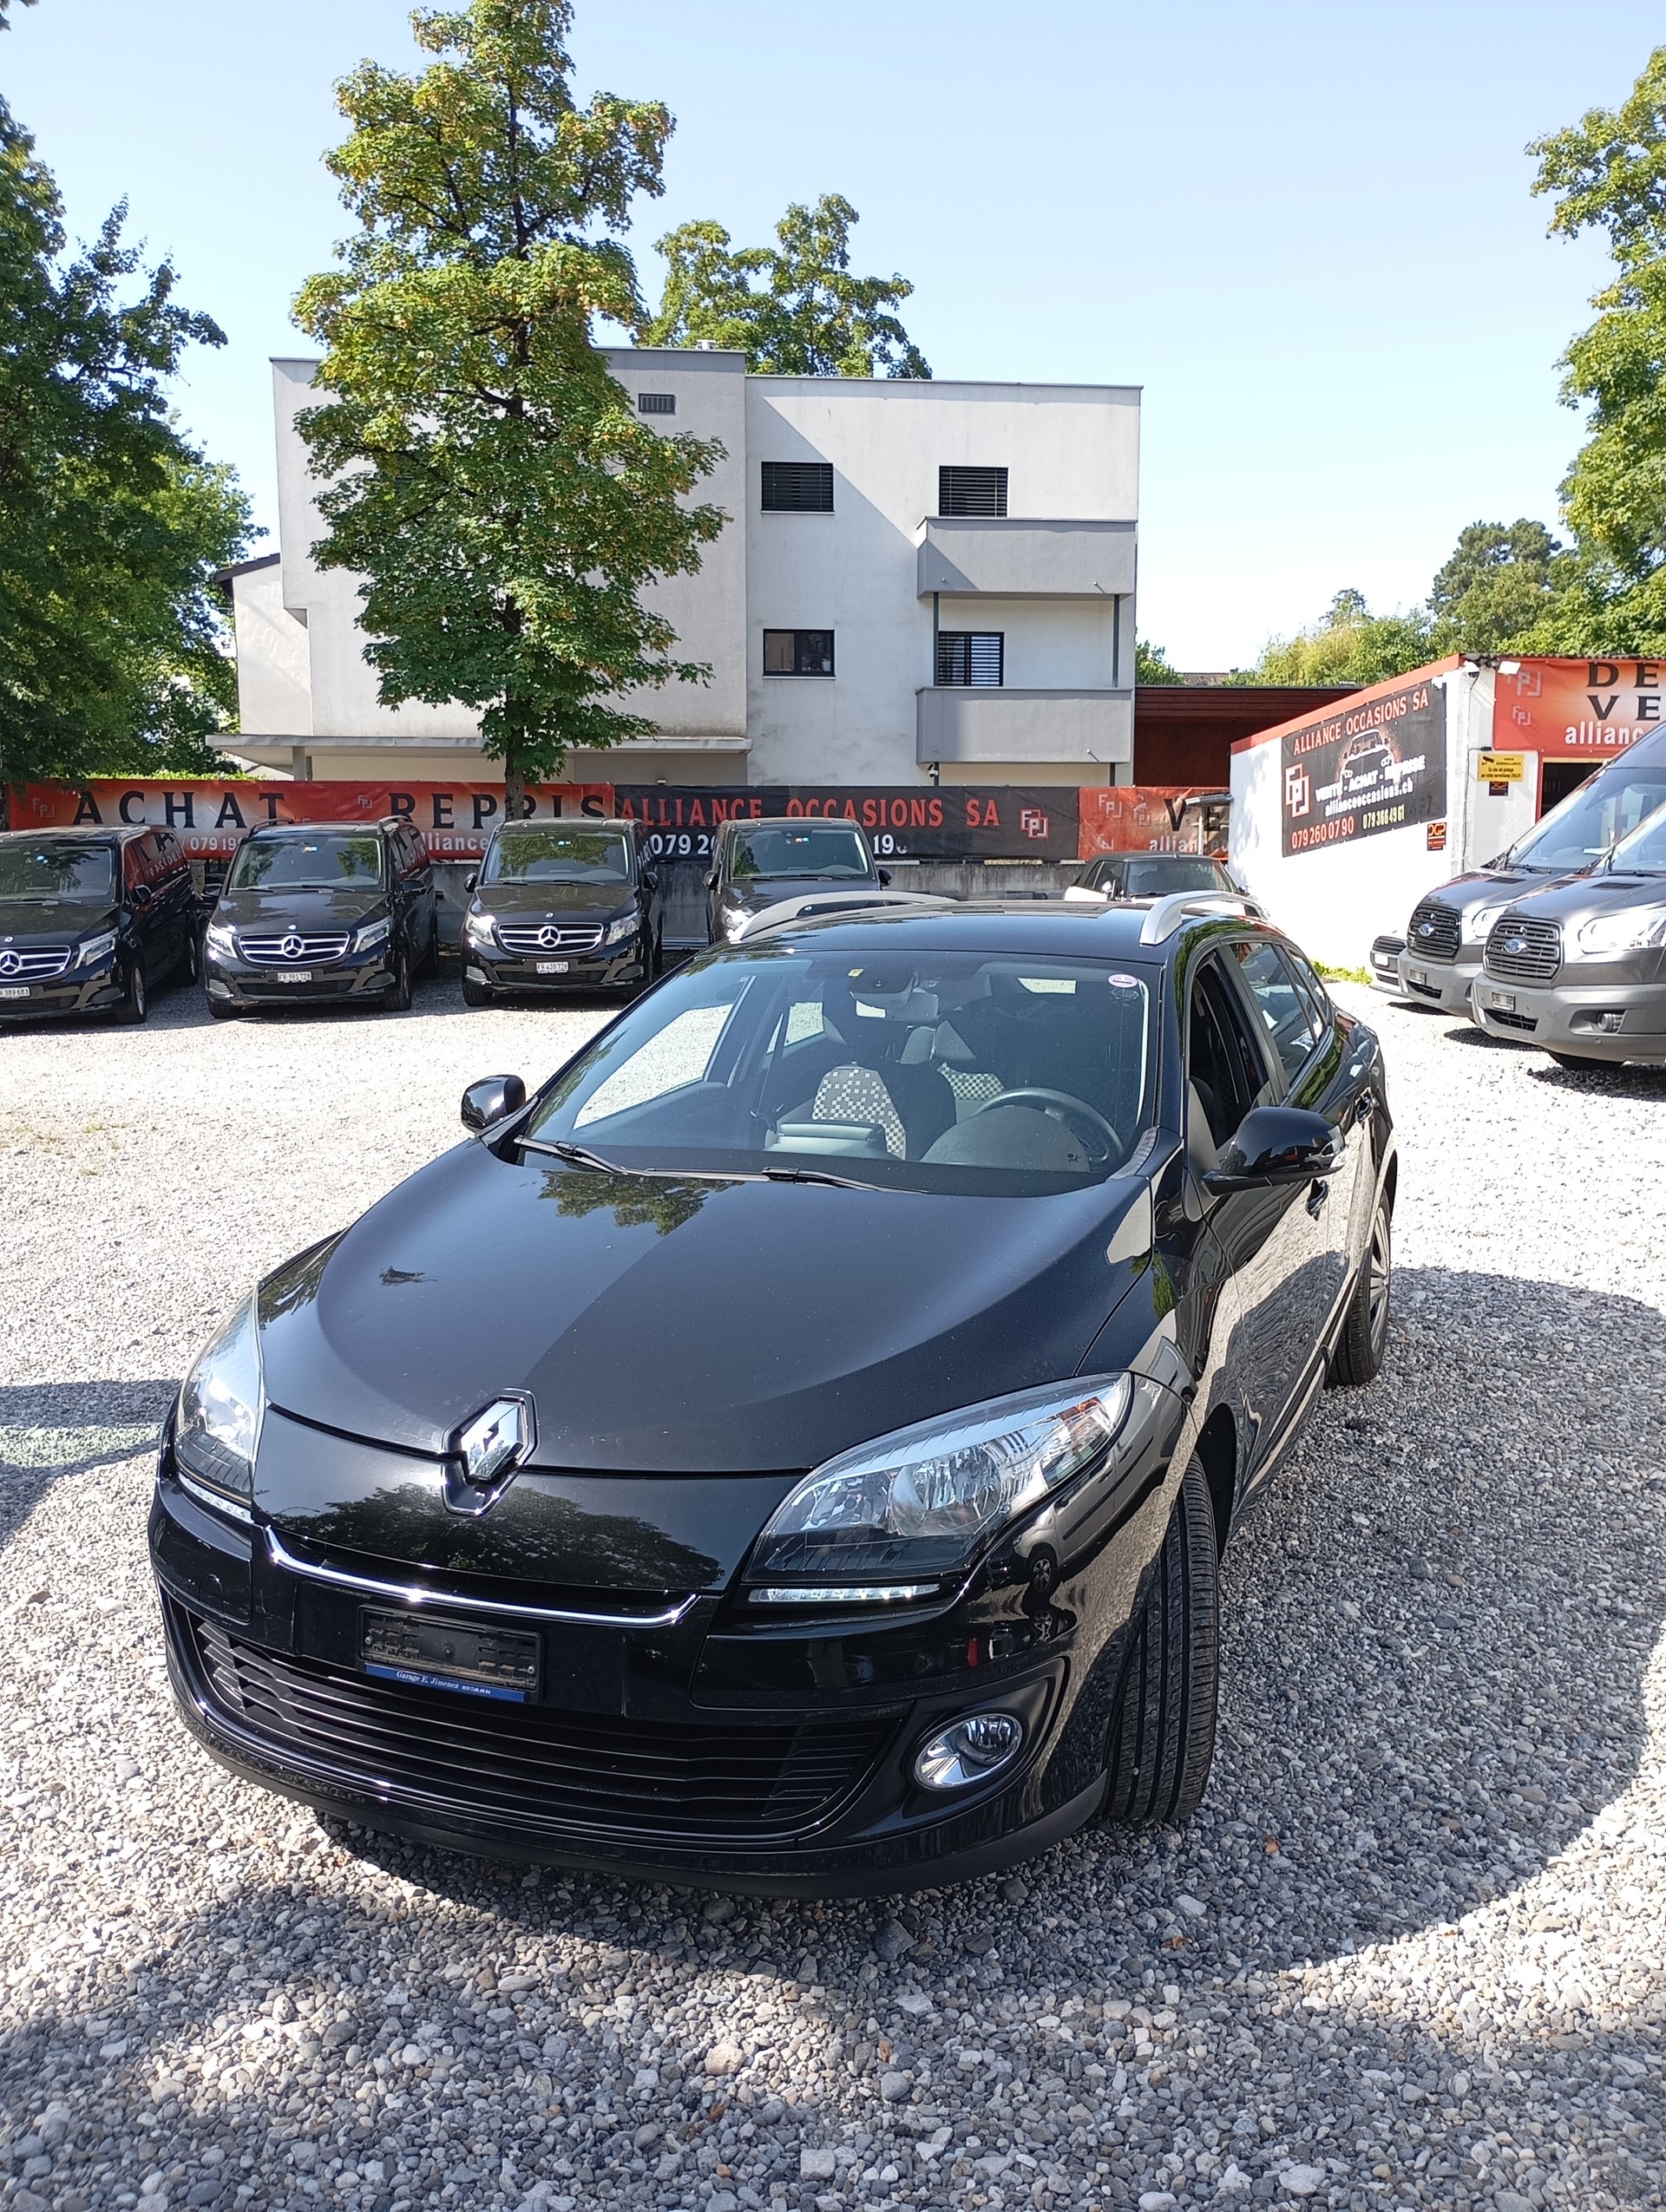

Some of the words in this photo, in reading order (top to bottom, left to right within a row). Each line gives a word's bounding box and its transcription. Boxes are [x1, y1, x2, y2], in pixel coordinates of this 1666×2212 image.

[1585, 662, 1660, 688] DE
[1587, 695, 1661, 721] VE
[1293, 721, 1341, 756] ALLIANCE
[1346, 696, 1407, 736] OCCASIONS
[1413, 688, 1430, 711] SA
[73, 790, 285, 828] ACHAT
[1324, 777, 1414, 816] allianceoccasions.ch
[620, 797, 764, 827] ALLIANCE
[786, 798, 943, 828] OCCASIONS
[966, 798, 1000, 828] SA
[191, 836, 218, 850] 079
[222, 836, 244, 851] 19
[651, 834, 692, 855] 079
[396, 1671, 420, 1683] Garage
[430, 1678, 460, 1689] Jimenez
